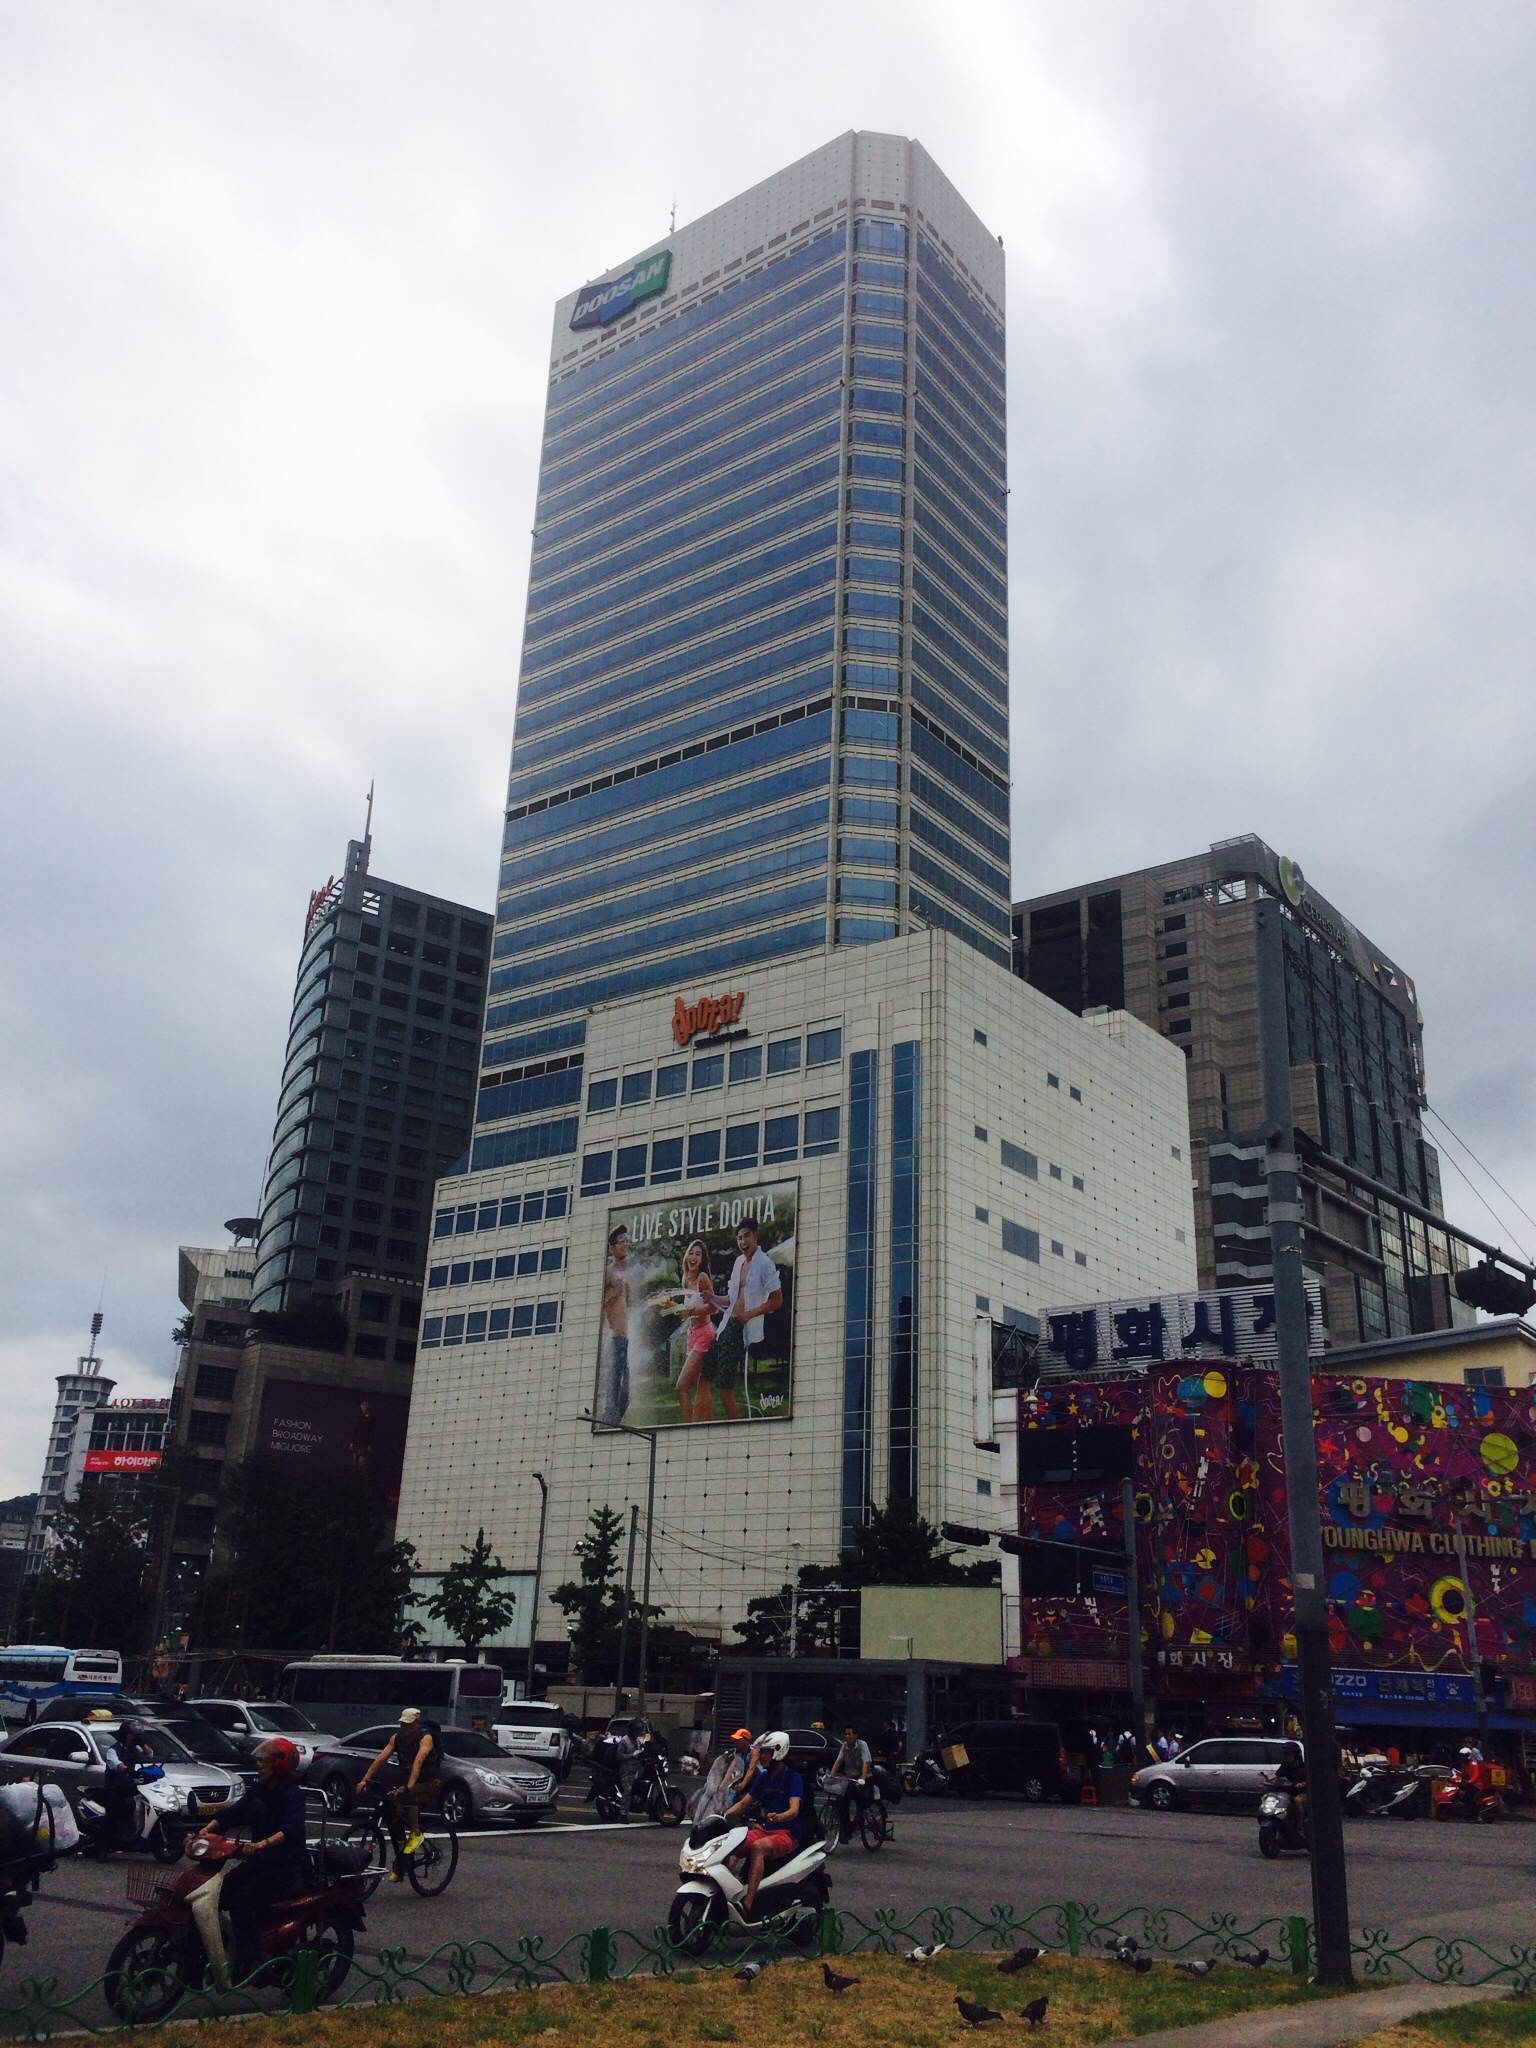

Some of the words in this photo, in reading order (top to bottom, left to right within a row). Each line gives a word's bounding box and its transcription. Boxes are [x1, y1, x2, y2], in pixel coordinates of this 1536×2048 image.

[573, 257, 666, 322] DOOSAN
[631, 1211, 663, 1243] LIVE
[668, 1203, 714, 1237] STYLE
[271, 1429, 325, 1444] BROADWAY
